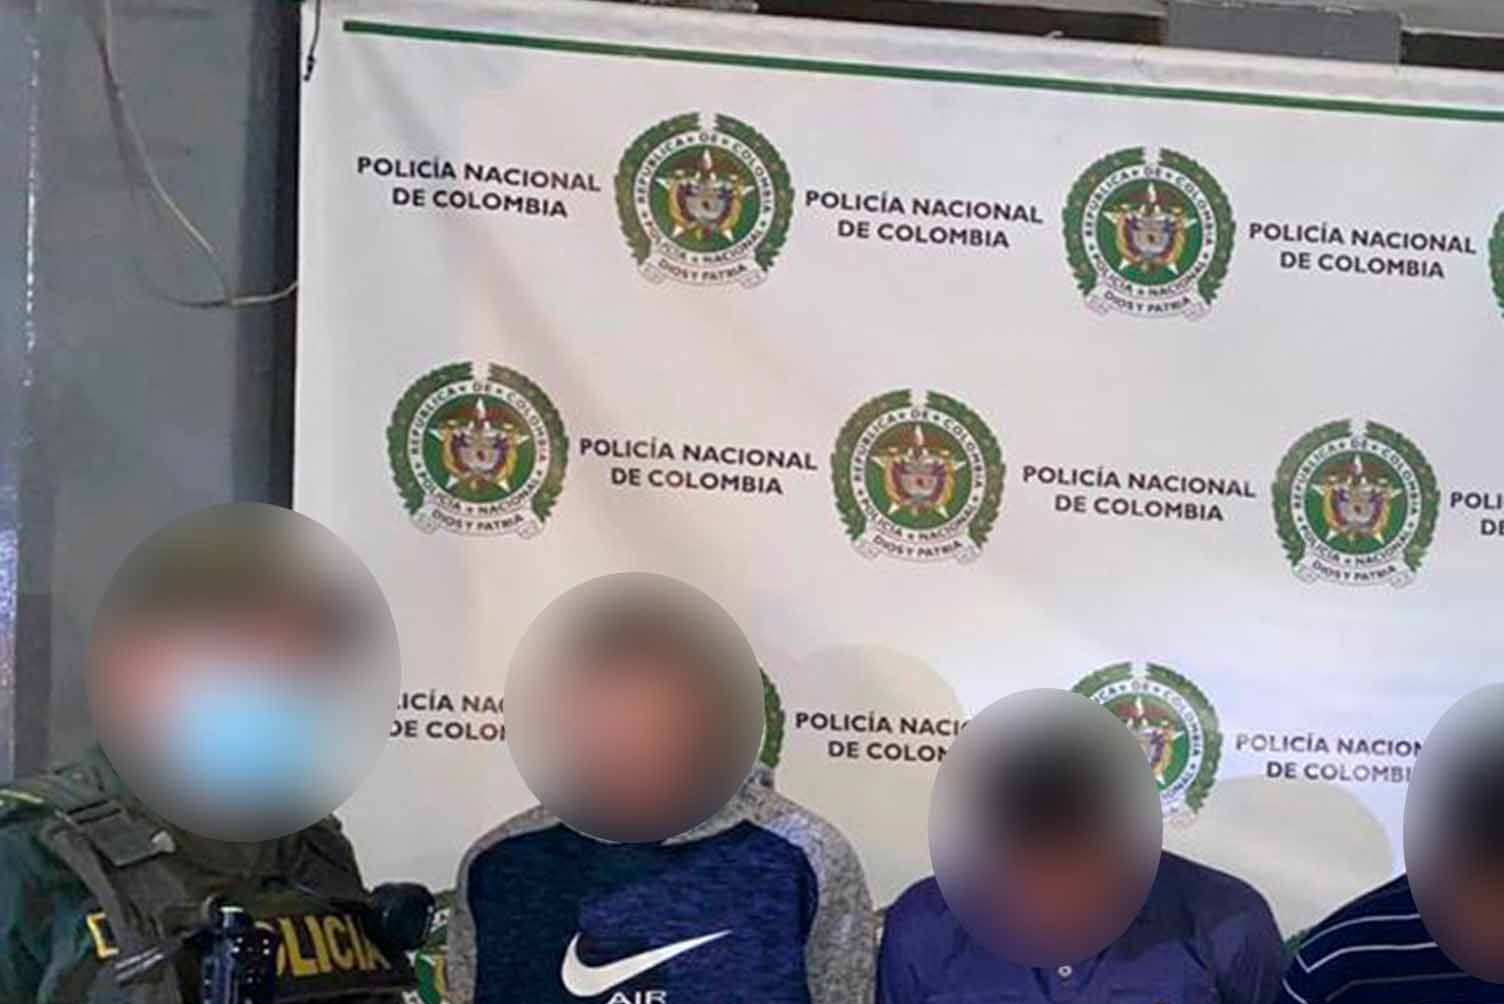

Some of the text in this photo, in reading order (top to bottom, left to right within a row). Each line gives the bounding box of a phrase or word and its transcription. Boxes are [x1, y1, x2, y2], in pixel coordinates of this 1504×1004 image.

[357, 156, 601, 192] POLICÍA NACIONAL
[392, 187, 568, 218] DE COLOMBIA
[805, 190, 1043, 224] POLICÍA NACIONAL
[838, 219, 1010, 249] DE COLOMBIA
[1249, 222, 1477, 255] POLICÍA NACIONAL
[1280, 251, 1445, 279] DE COLOMBIA
[580, 436, 818, 471] POLICÍA NACIONAL
[611, 467, 783, 495] DE COLOMBIA
[1023, 465, 1256, 498] POLICÍA NACIONAL
[1055, 494, 1224, 522] DE COLOMBIA
[397, 690, 454, 711] ICÍA
[795, 710, 968, 736] POLICÍA NACI
[827, 740, 859, 759] DE
[1236, 732, 1330, 754] POLICÍA
[1266, 761, 1297, 779] DE
